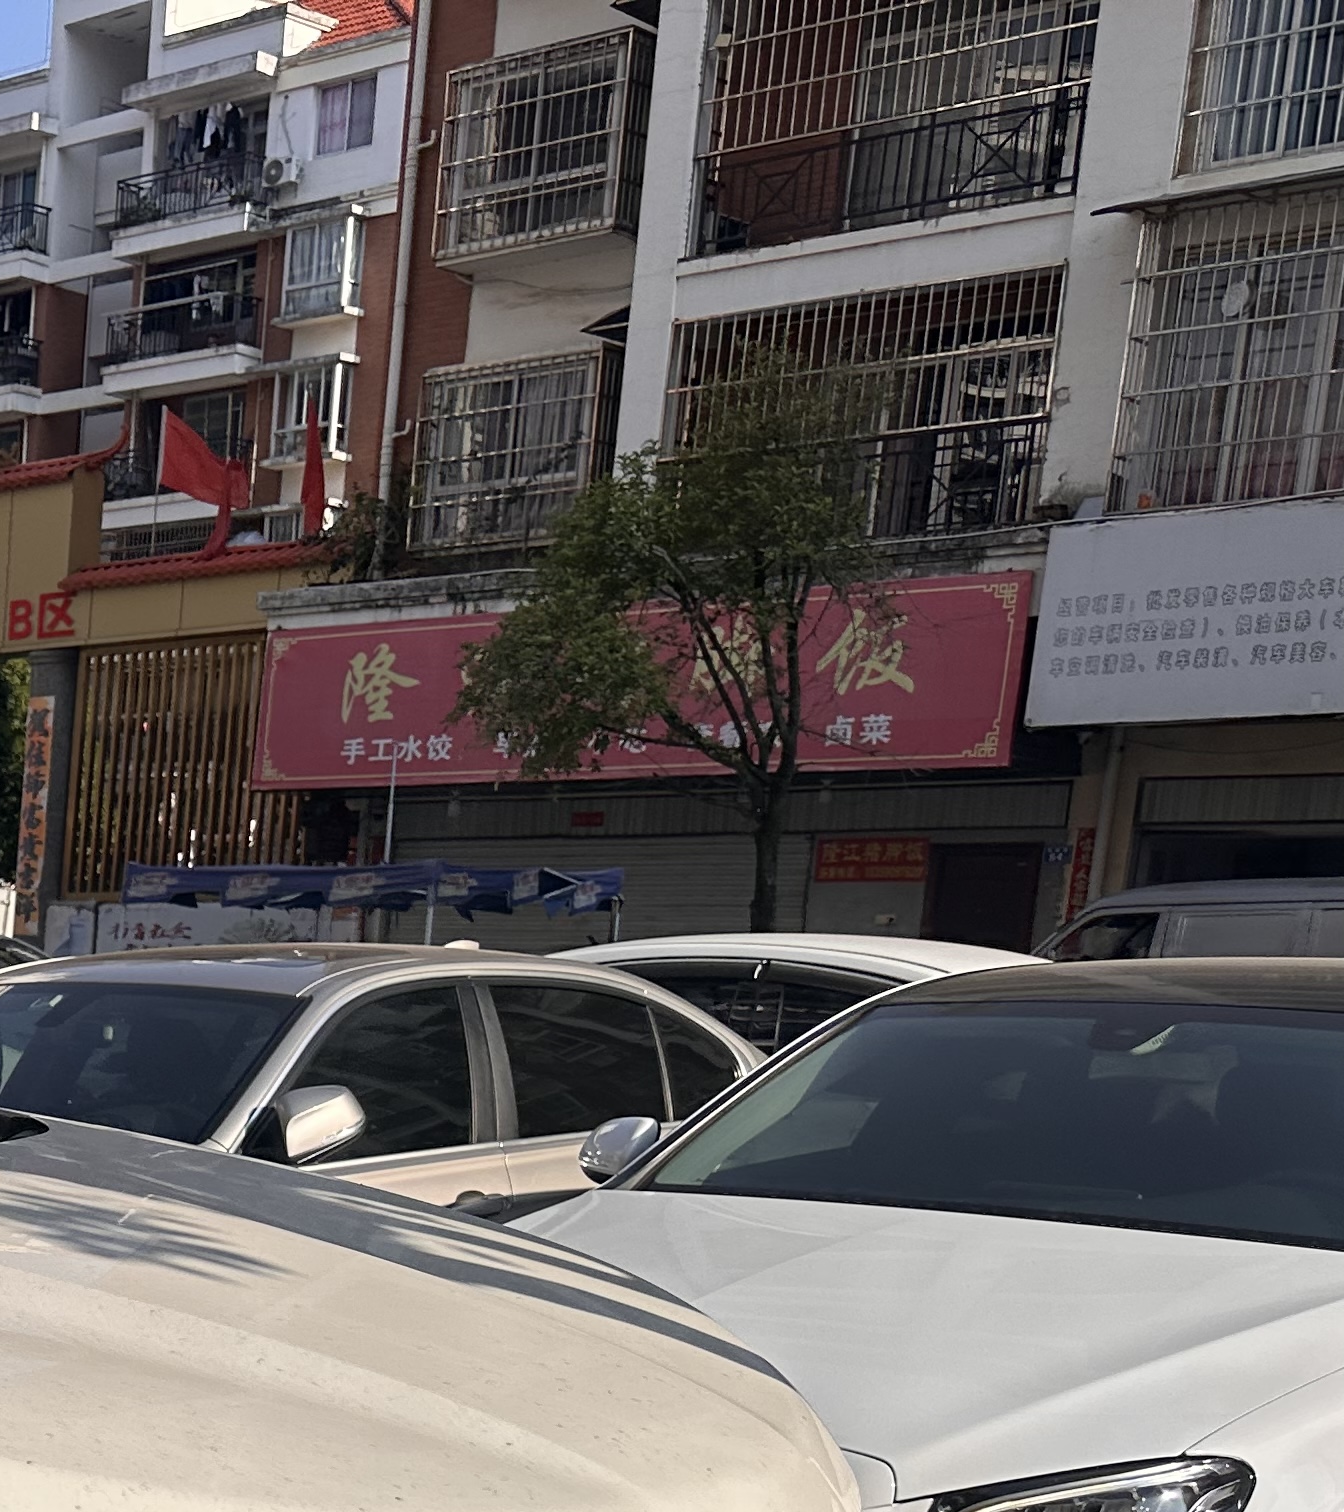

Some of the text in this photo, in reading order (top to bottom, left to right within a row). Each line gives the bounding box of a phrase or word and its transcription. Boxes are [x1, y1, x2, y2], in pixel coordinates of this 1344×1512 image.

[7, 591, 76, 640] B区
[340, 733, 454, 765] 手工水饺
